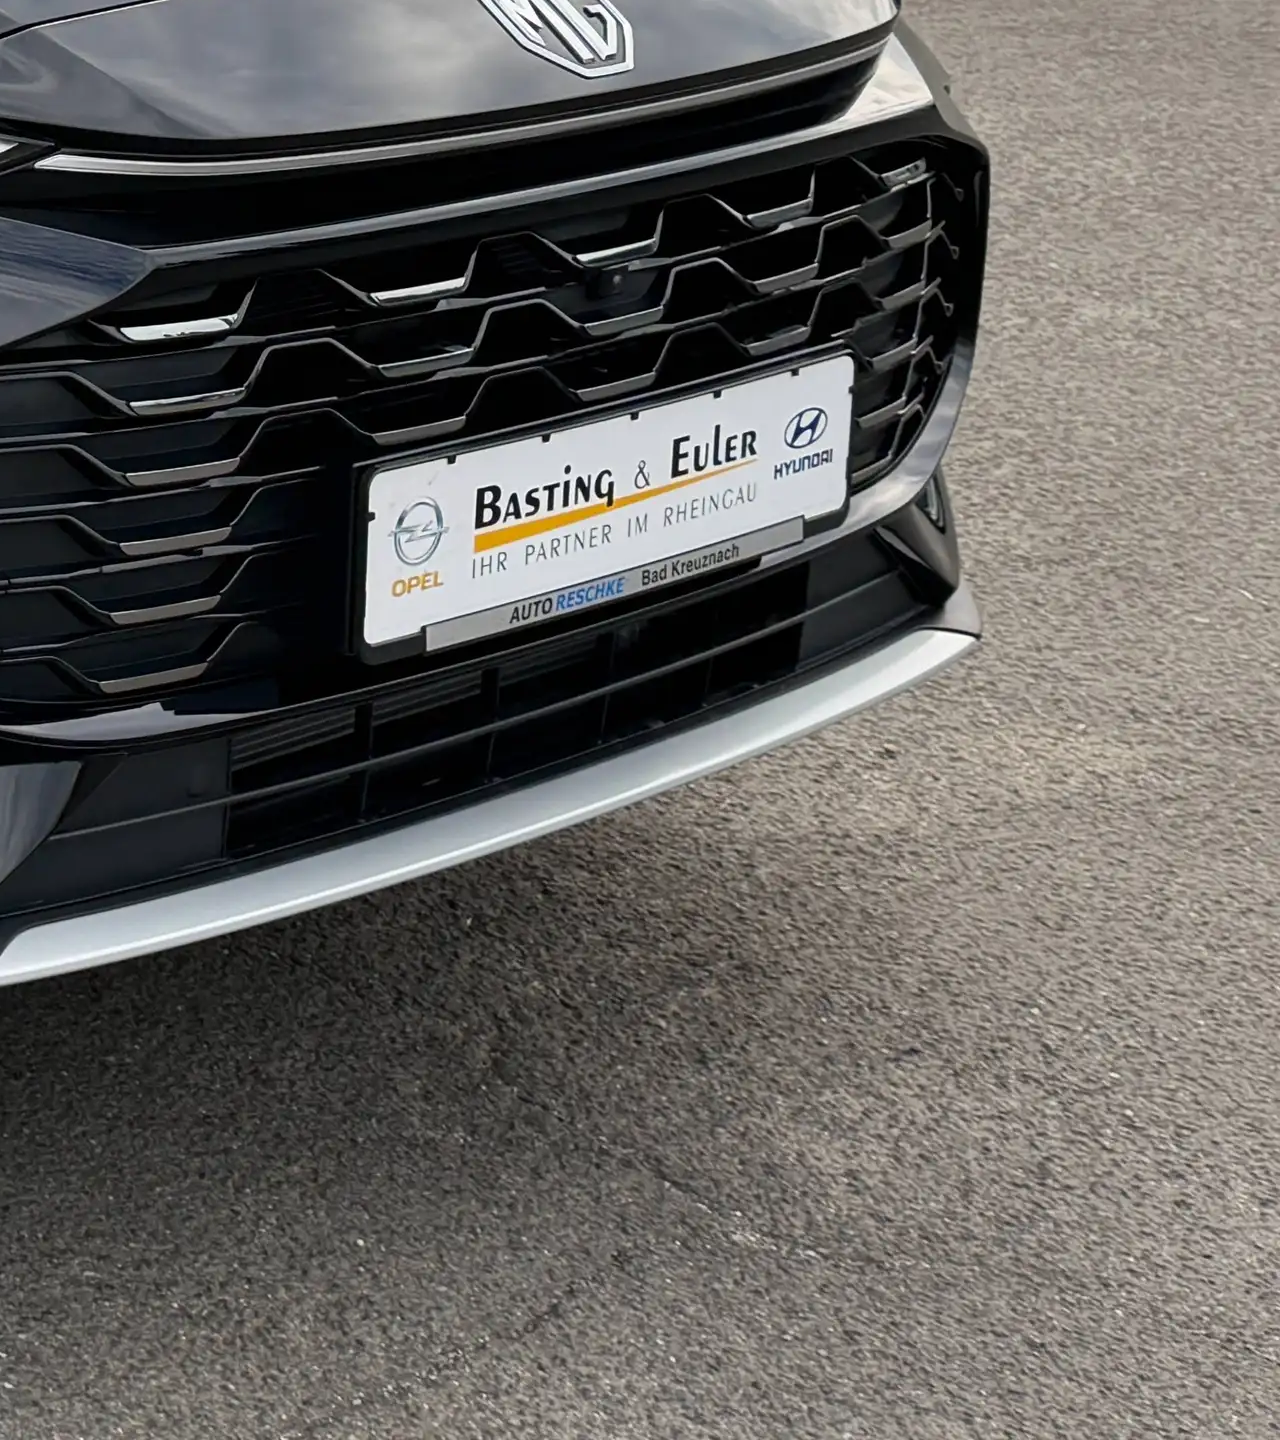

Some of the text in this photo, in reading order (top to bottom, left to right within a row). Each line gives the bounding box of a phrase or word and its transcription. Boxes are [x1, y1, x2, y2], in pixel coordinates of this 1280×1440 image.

[634, 460, 651, 490] &
[773, 449, 834, 480] HYUNDAI
[472, 482, 758, 579] IHR PARTNER IM RHEINGAU
[392, 571, 444, 598] OPEL
[509, 542, 740, 624] AUTO RESCHKE Bad Kreuznach
